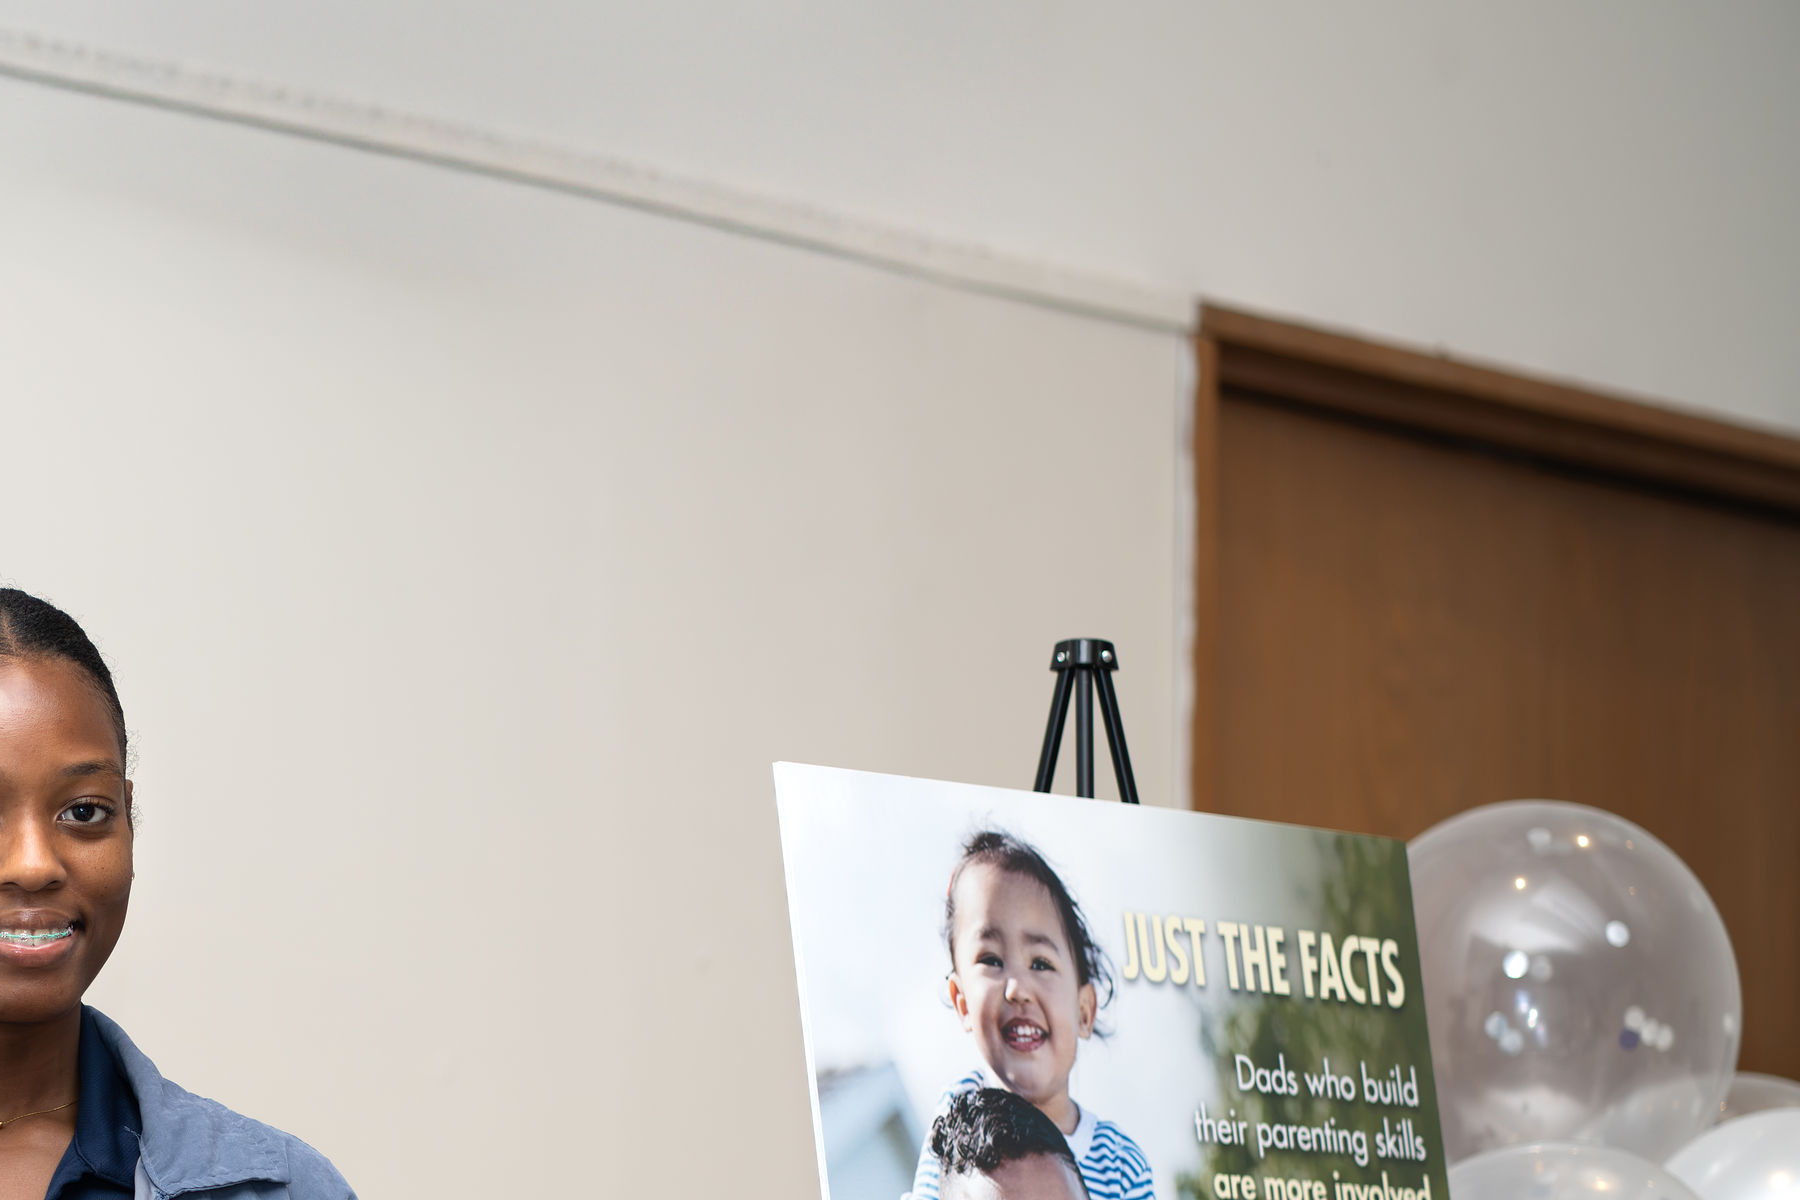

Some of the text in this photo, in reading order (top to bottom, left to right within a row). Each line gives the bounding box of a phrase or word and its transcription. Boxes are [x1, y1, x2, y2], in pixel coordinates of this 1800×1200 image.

[1122, 911, 1406, 1009] JUST THE FACTS
[1235, 1053, 1419, 1107] Dads who build
[1194, 1102, 1427, 1167] their parenting skills
